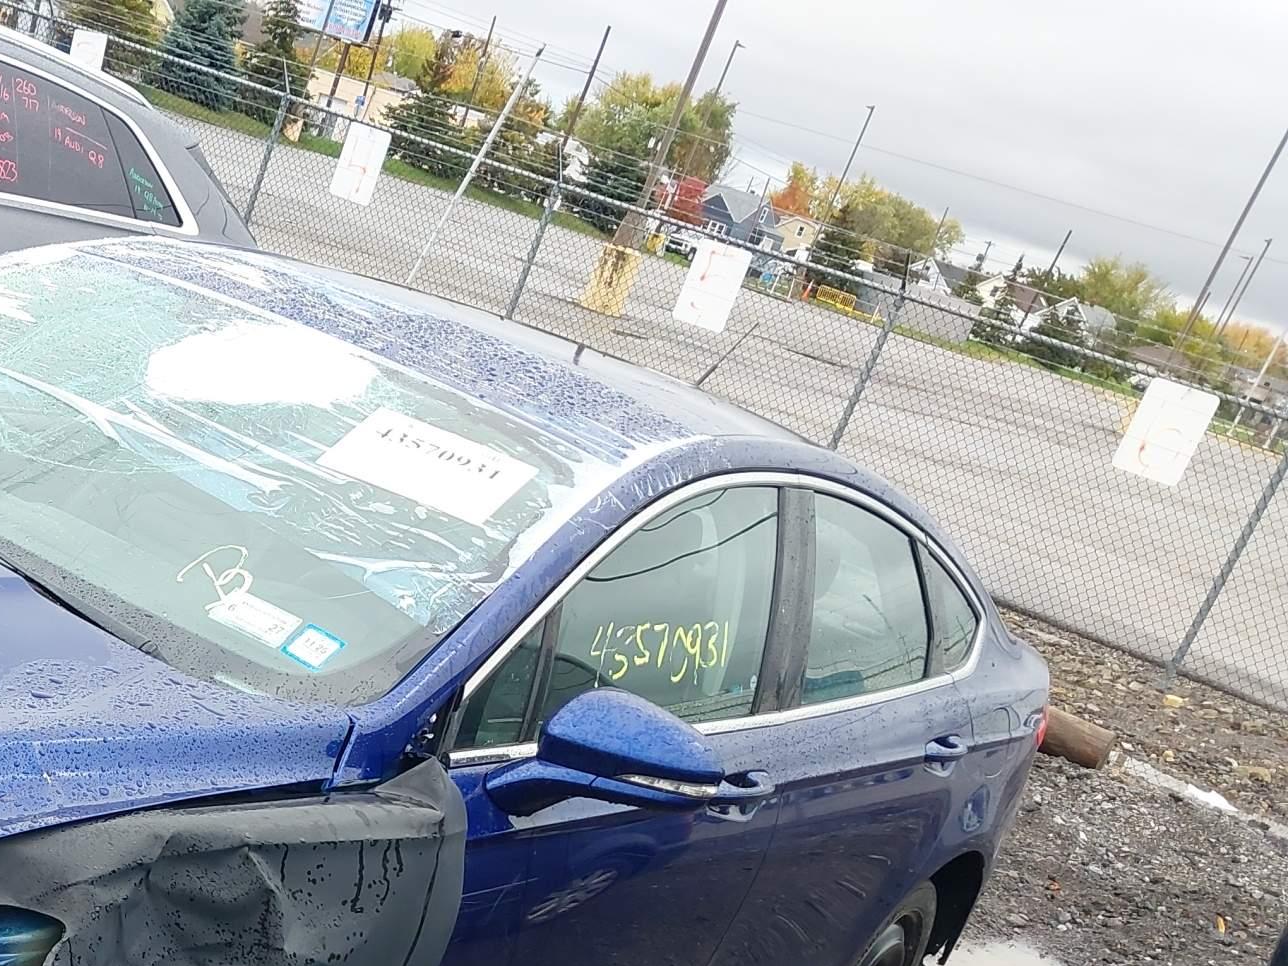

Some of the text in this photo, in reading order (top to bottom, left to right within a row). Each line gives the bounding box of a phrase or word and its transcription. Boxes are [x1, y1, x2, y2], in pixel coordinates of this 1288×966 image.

[15, 78, 37, 96] 260
[88, 150, 105, 169] Q8
[376, 428, 501, 480] 43570931
[590, 620, 729, 688] 43570931
